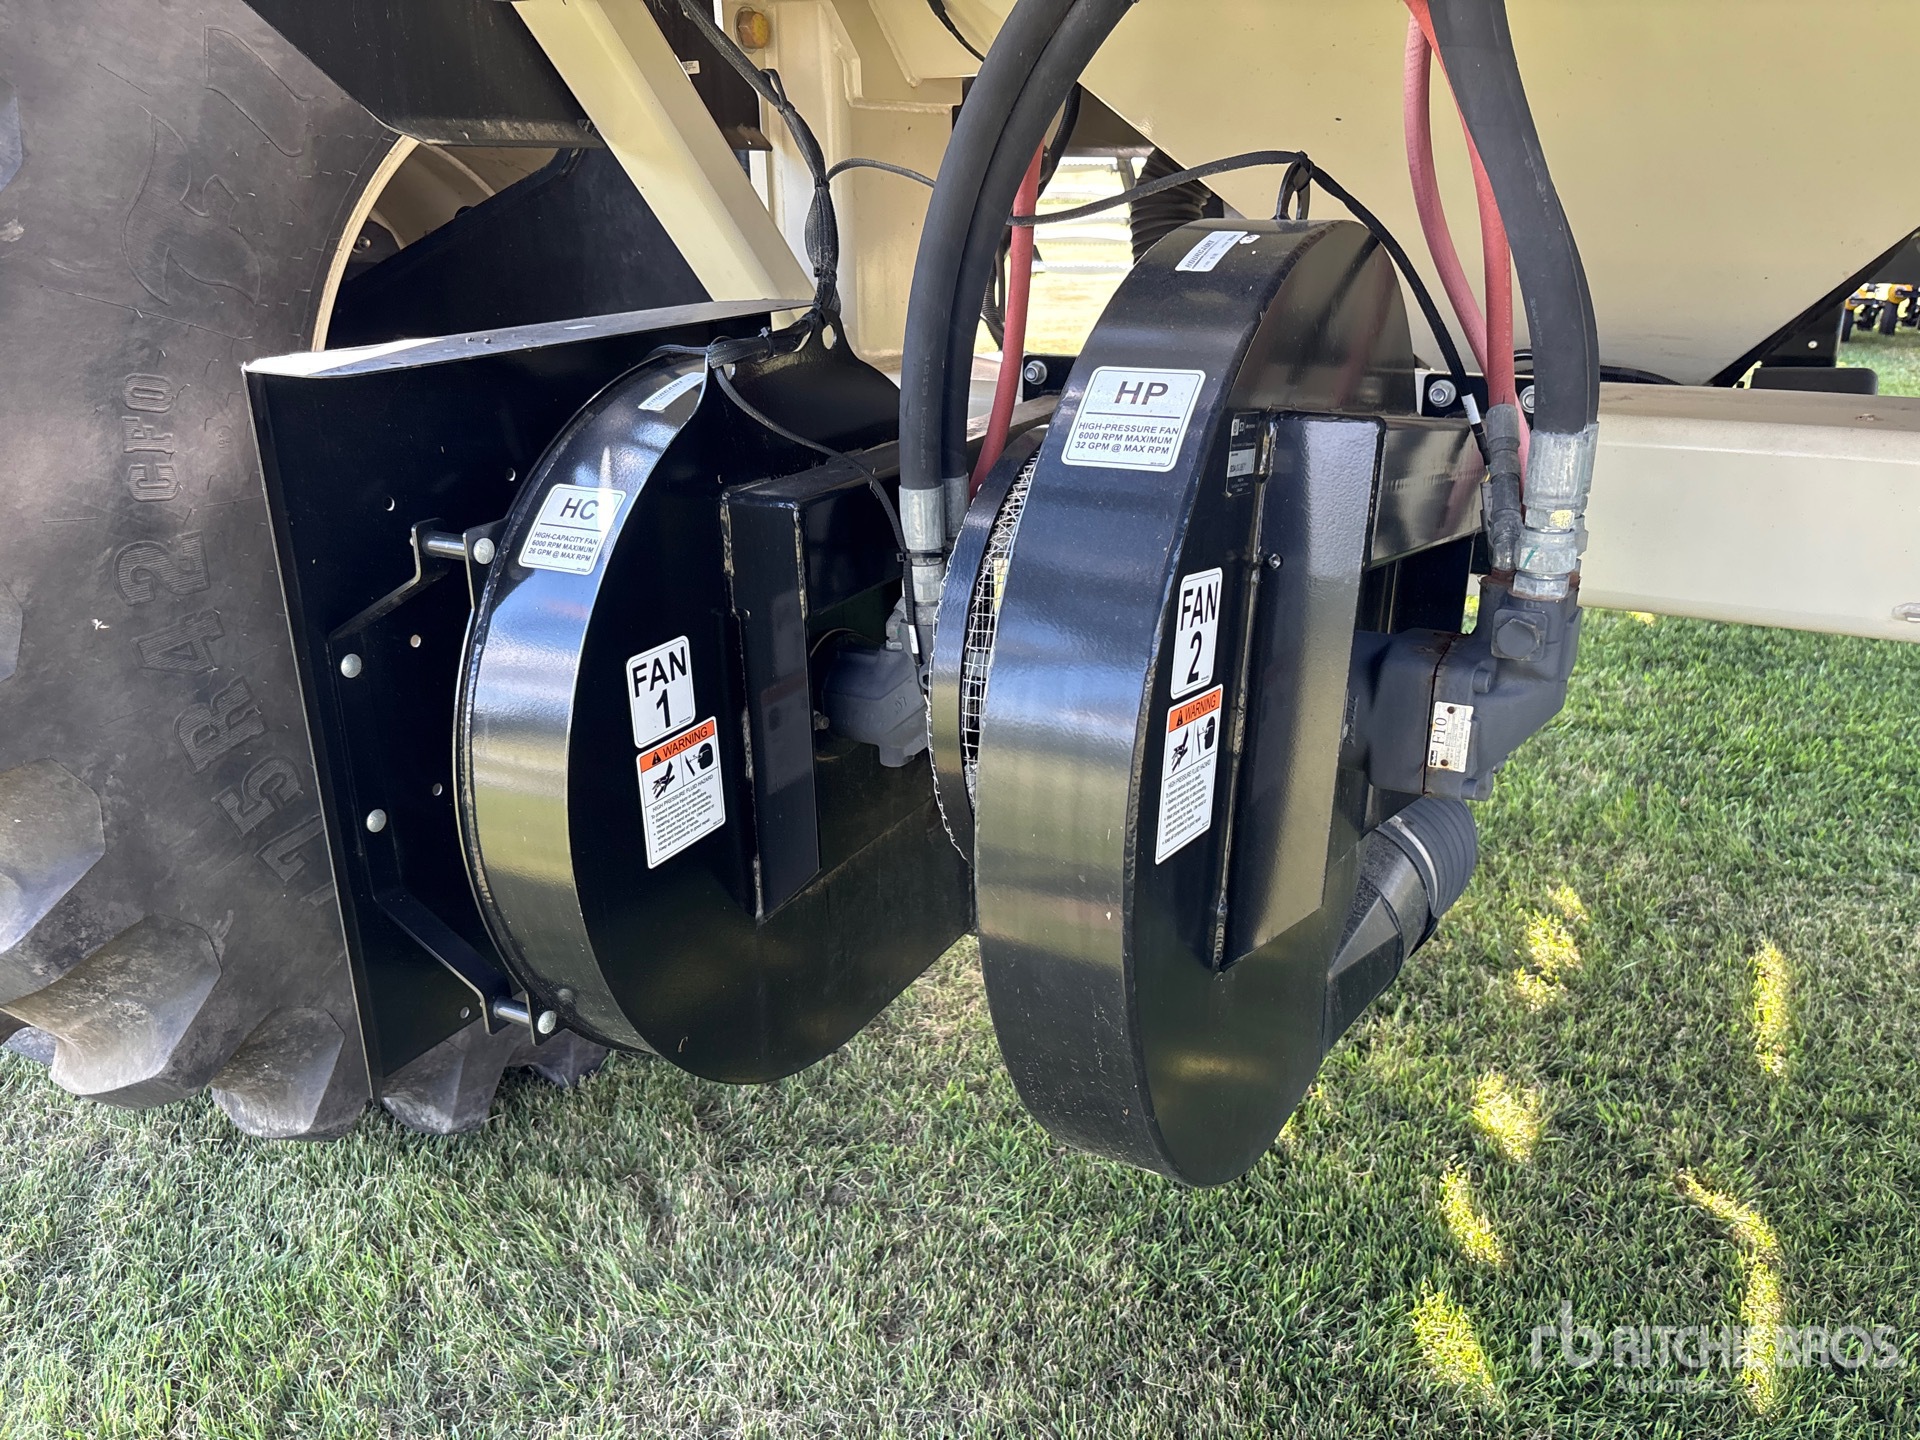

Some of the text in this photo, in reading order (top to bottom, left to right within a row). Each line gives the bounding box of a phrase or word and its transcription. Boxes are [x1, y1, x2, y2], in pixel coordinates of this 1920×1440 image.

[1114, 381, 1169, 405] HP
[122, 372, 181, 502] CFO
[1078, 422, 1179, 435] HIGH-PRESSURE FAN
[1078, 432, 1172, 444] 6000 RPM MAXIMUM
[1075, 441, 1169, 455] 32 GPM @ MAX RPM
[560, 497, 600, 520] HC
[534, 531, 598, 546] HIGH-CAPACITY FAN
[547, 541, 561, 549] RPM
[562, 543, 595, 553] MAXIMUM
[536, 548, 552, 556] GPM
[552, 550, 560, 558] @
[561, 551, 575, 560] MAX
[576, 553, 591, 561] RPM
[1180, 581, 1218, 631] FAN
[1186, 630, 1202, 685] 2
[632, 646, 687, 698] FAN
[656, 688, 671, 729] 1
[1185, 694, 1216, 721] WARNING
[662, 726, 708, 758] WARNING
